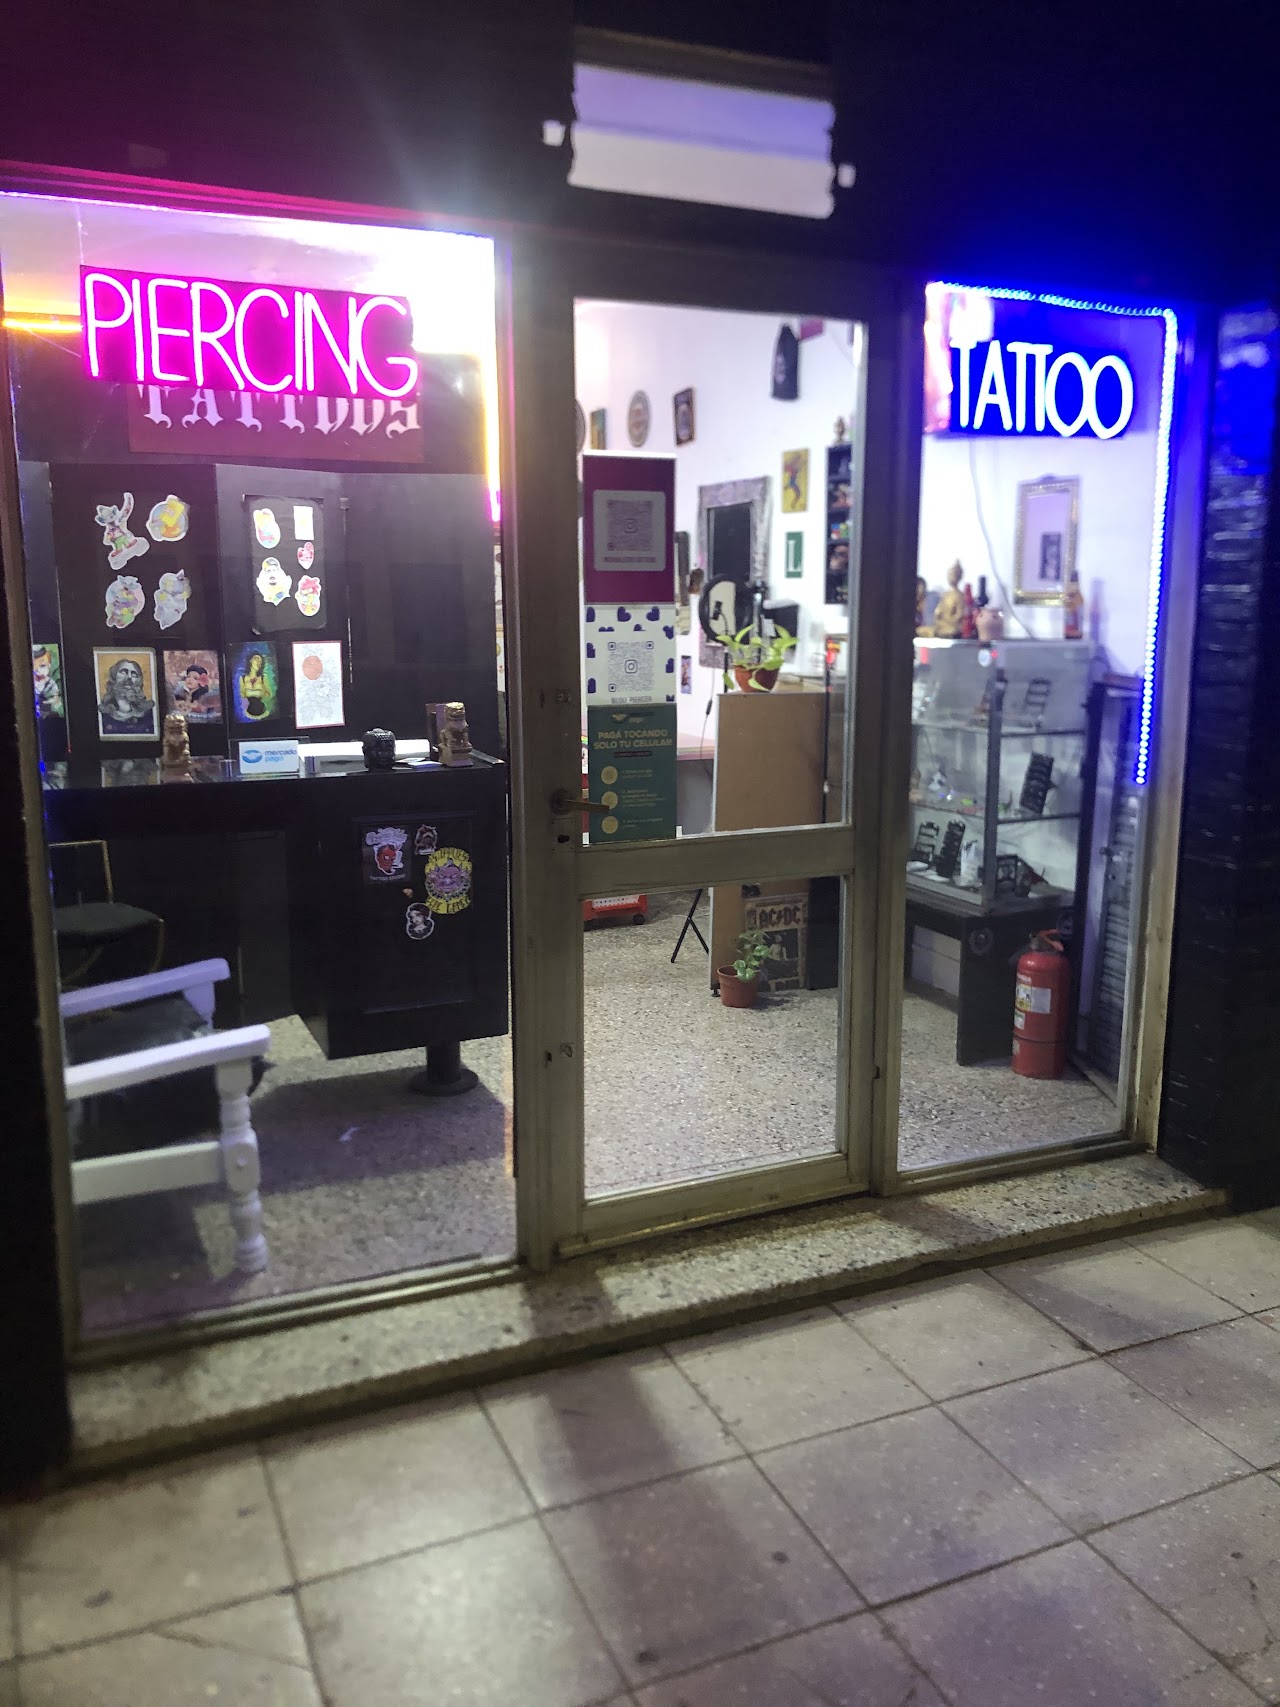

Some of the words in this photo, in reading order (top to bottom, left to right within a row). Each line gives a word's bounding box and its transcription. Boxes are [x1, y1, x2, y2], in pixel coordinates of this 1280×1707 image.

[84, 271, 418, 397] PIERCING
[950, 339, 1134, 439] TATTOO
[593, 741, 618, 750] SOLO
[619, 740, 631, 748] TU
[633, 739, 673, 748] CELULAR
[623, 729, 668, 738] TOCANDO
[758, 906, 801, 929] AC/DC
